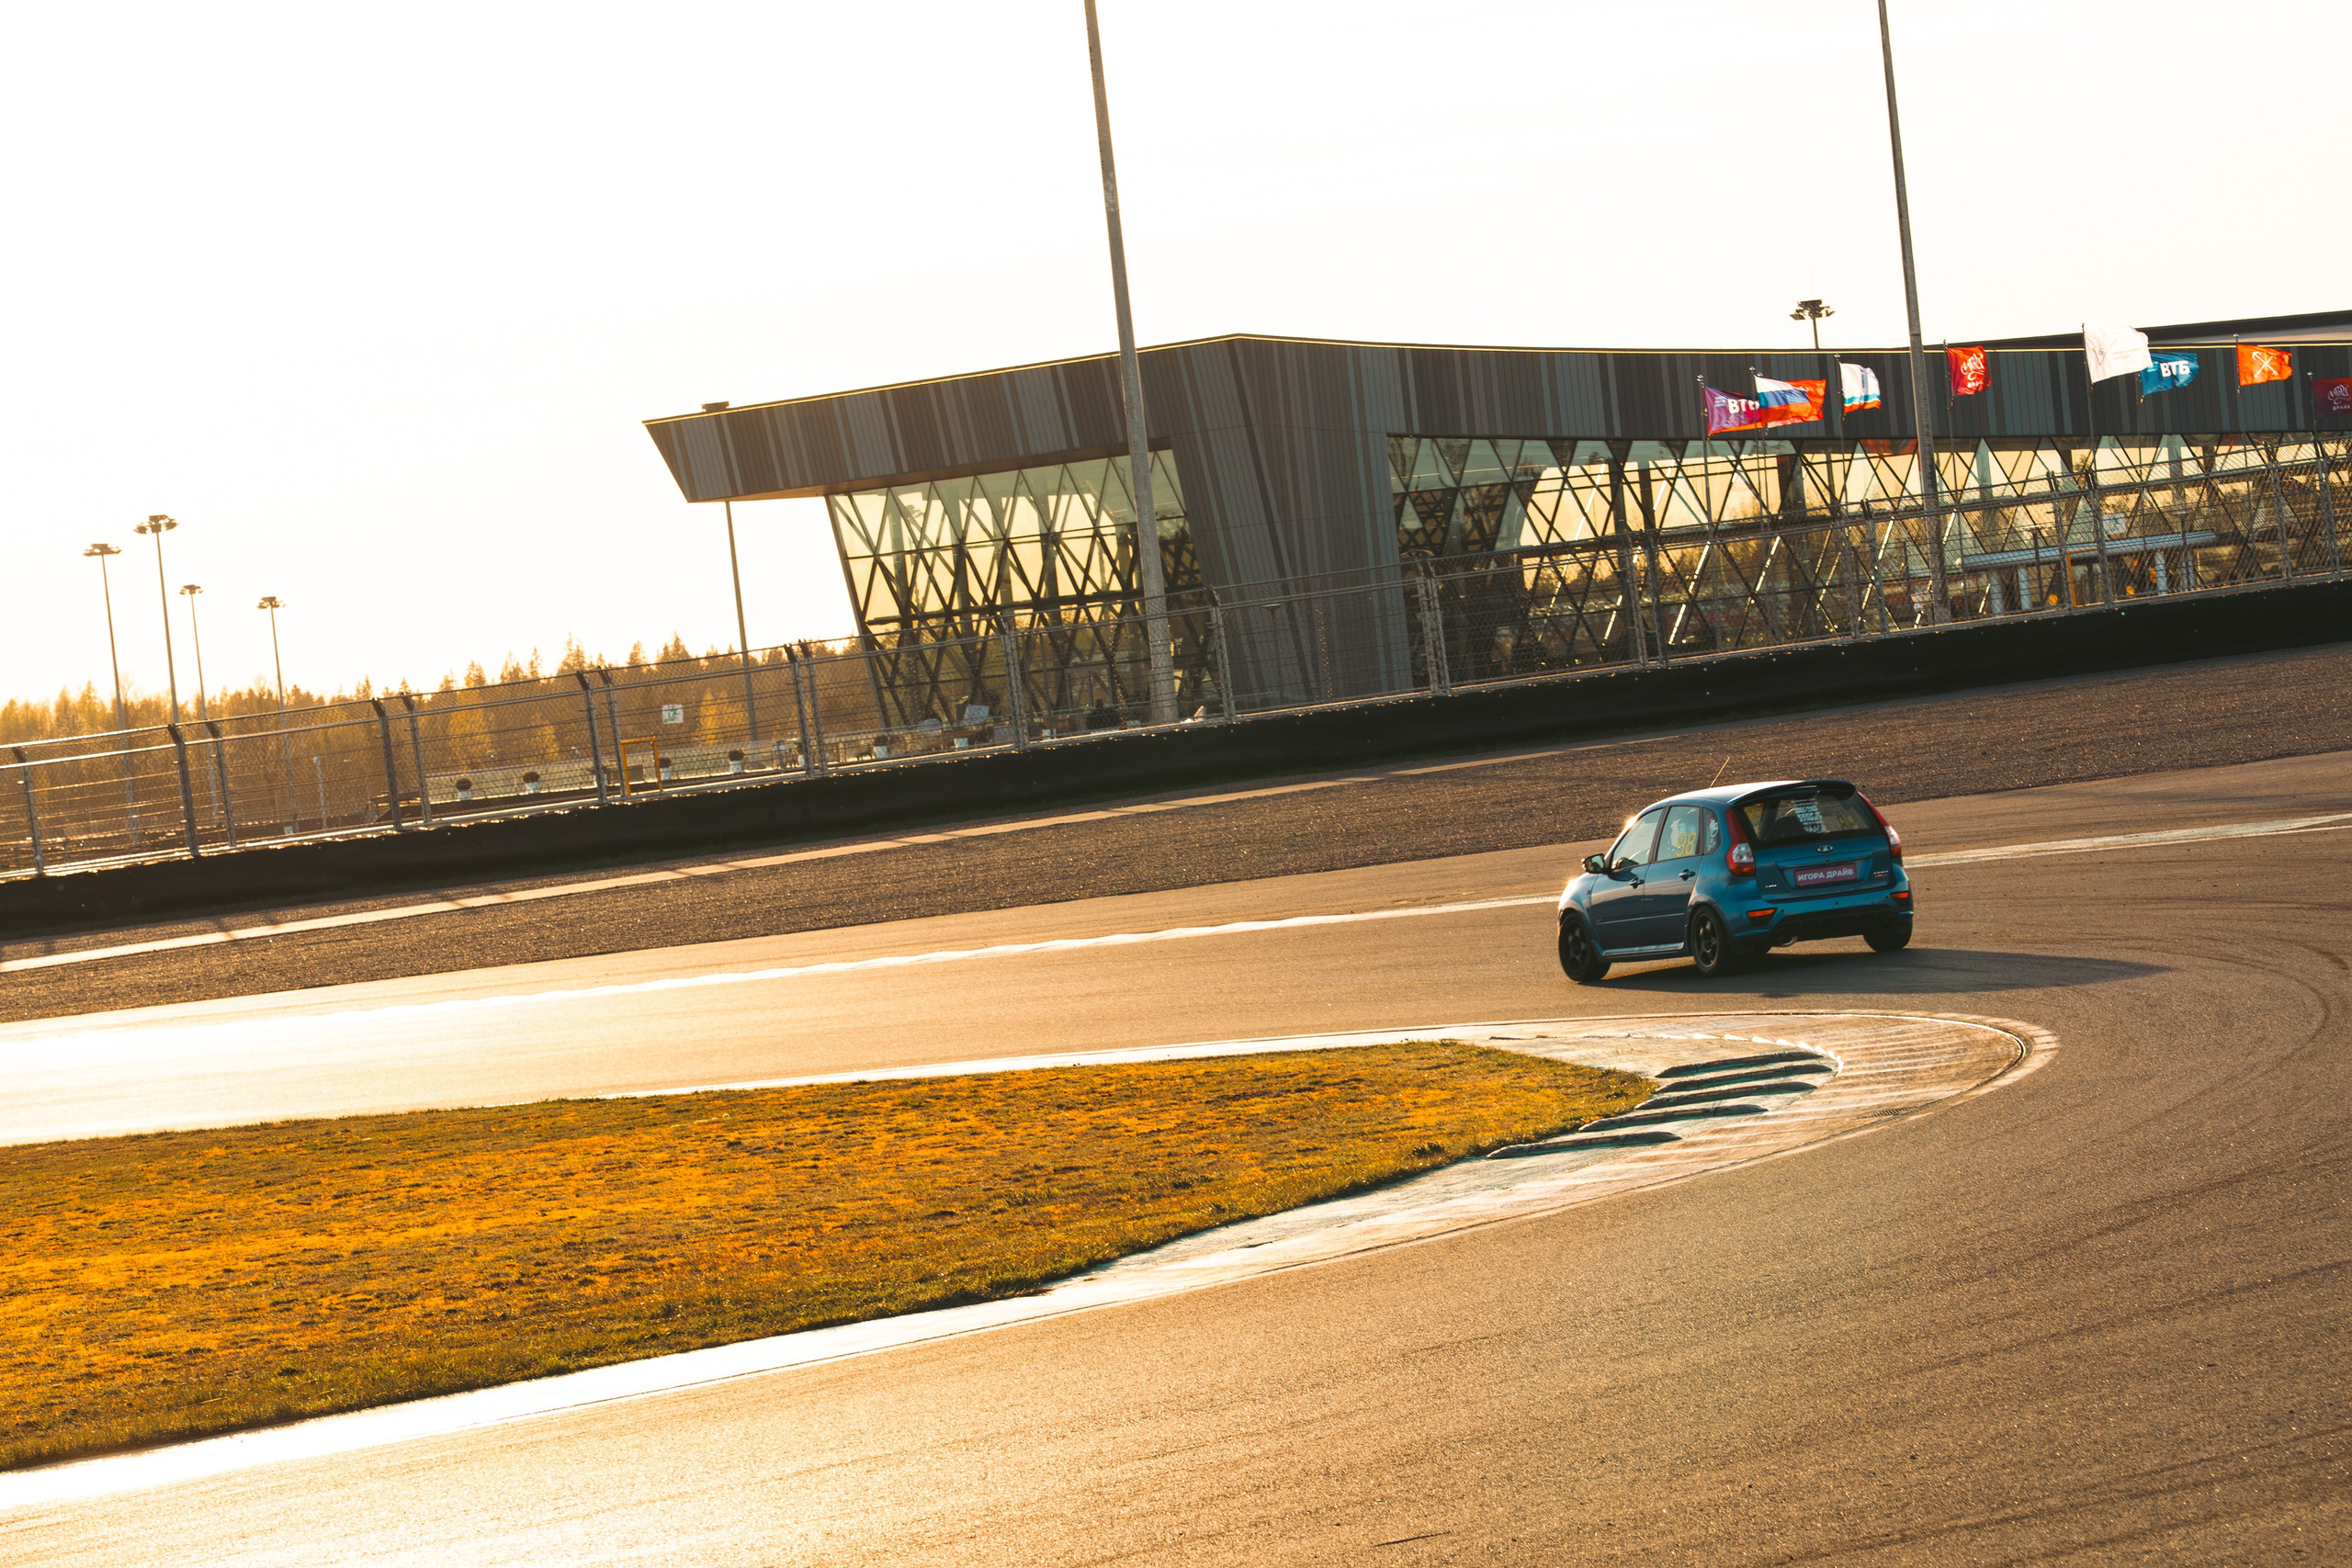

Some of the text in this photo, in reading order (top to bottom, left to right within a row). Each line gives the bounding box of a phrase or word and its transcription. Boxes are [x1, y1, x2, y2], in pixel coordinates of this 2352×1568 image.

[2160, 360, 2190, 378] ВТБ
[1675, 830, 1697, 857] 98
[1797, 867, 1854, 882] ИГОРА ДРАЙВ
